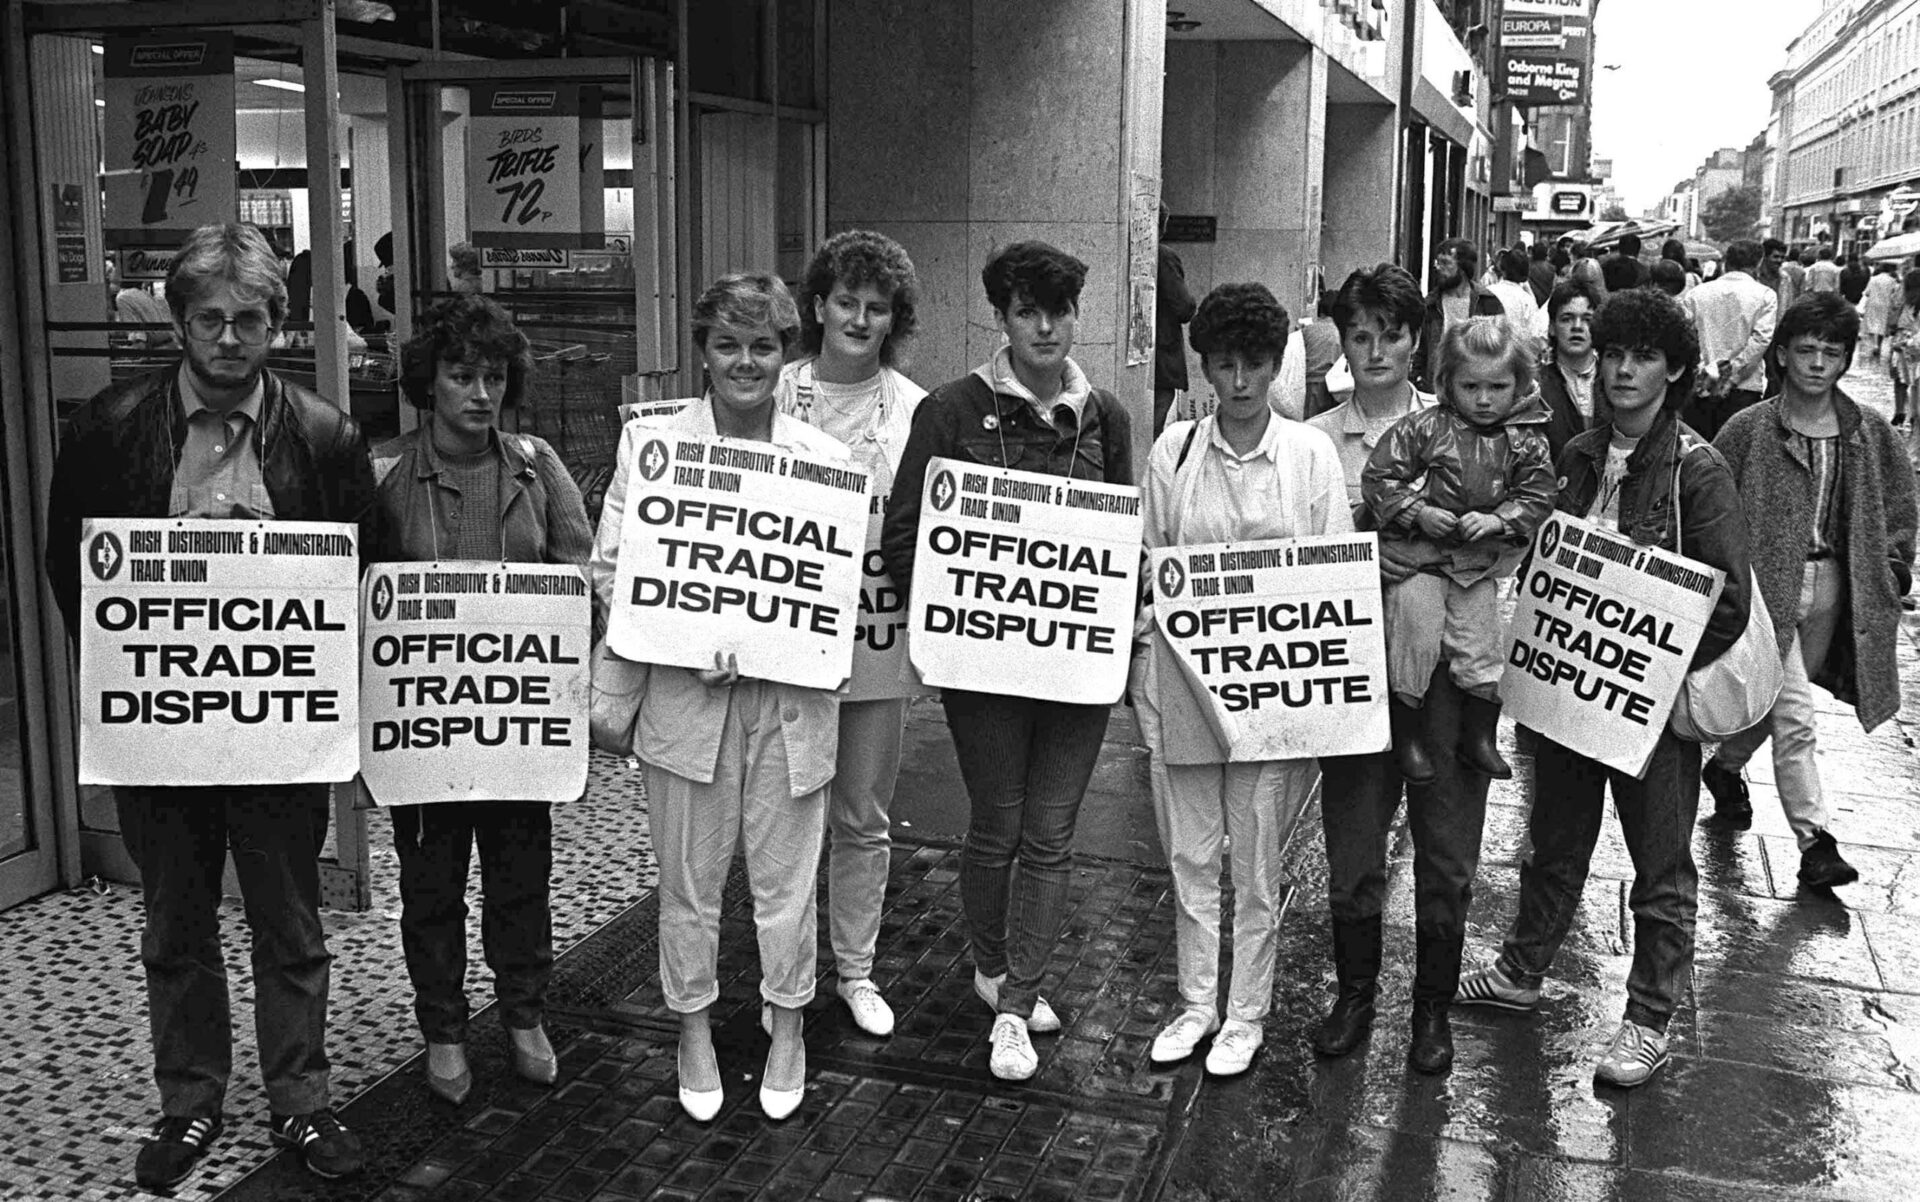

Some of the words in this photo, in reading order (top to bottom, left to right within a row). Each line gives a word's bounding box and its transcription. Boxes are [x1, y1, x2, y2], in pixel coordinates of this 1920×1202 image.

[1504, 20, 1550, 32] EUROPA
[1507, 59, 1553, 74] Osborne
[1555, 62, 1579, 79] King
[1507, 73, 1531, 86] and
[528, 96, 552, 105] OFFER
[134, 101, 199, 140] BABY
[499, 127, 543, 149] BIRDS
[132, 131, 192, 169] SOAP
[487, 144, 559, 184] TRIFLE
[673, 466, 705, 488] TRADE
[708, 469, 742, 493] UNION
[675, 441, 705, 463] IRISH
[709, 445, 775, 475] DISTRIBUTIVE
[779, 457, 788, 476] &
[790, 459, 868, 494] ADMINISTRATIVE
[960, 496, 988, 520] TRADE
[991, 501, 1021, 524] UNION
[962, 472, 988, 494] IRISH
[992, 476, 1052, 504] DISTRIBUTIVE
[1055, 487, 1062, 505] &
[1065, 488, 1140, 516] ADMINISTRATIVE
[130, 530, 162, 553] IRISH
[168, 531, 244, 554] DISTRIBUTIVE
[249, 531, 259, 554] &
[263, 532, 352, 557] ADMINISTRATIVE
[637, 495, 853, 558] OFFICIAL
[657, 537, 824, 592] TRADE
[928, 525, 1127, 579] OFFICIAL
[1189, 553, 1216, 574] IRISH
[1220, 548, 1281, 572] DISTRIBUTIVE
[1286, 547, 1293, 567] &
[1297, 542, 1373, 566] ADMINISTRATIVE
[1555, 546, 1579, 570] TRADE
[1576, 555, 1604, 580] UNION
[1562, 524, 1585, 548] IRISH
[1583, 532, 1639, 568] DISTRIBUTIVE
[1634, 552, 1646, 571] &
[1644, 556, 1714, 598] ADMINISTRATIVE
[130, 559, 166, 582] TRADE
[171, 559, 207, 582] UNION
[397, 573, 420, 594] IRISH
[424, 573, 488, 594] DISTRIBUTIVE
[492, 573, 501, 594] &
[504, 573, 586, 597] ADMINISTRATIVE
[1191, 577, 1220, 597] TRADE
[1224, 574, 1254, 595] UNION
[630, 576, 840, 637] DISPUTE
[947, 567, 1099, 614] TRADE
[95, 596, 346, 632] OFFICIAL
[397, 599, 422, 621] TRADE
[426, 599, 456, 620] UNION
[1166, 598, 1373, 639] OFFICIAL
[1530, 570, 1683, 656] OFFICIAL
[924, 603, 1115, 655] DISPUTE
[1533, 608, 1652, 683] TRADE
[123, 644, 316, 677] TRADE
[372, 633, 579, 667] OFFICIAL
[1190, 638, 1349, 675] TRADE
[389, 675, 551, 708] TRADE
[1209, 675, 1372, 712] SPUTE
[1509, 638, 1656, 726] DISPUTE
[101, 689, 340, 725] DISPUTE
[372, 716, 572, 752] DISPUTE
